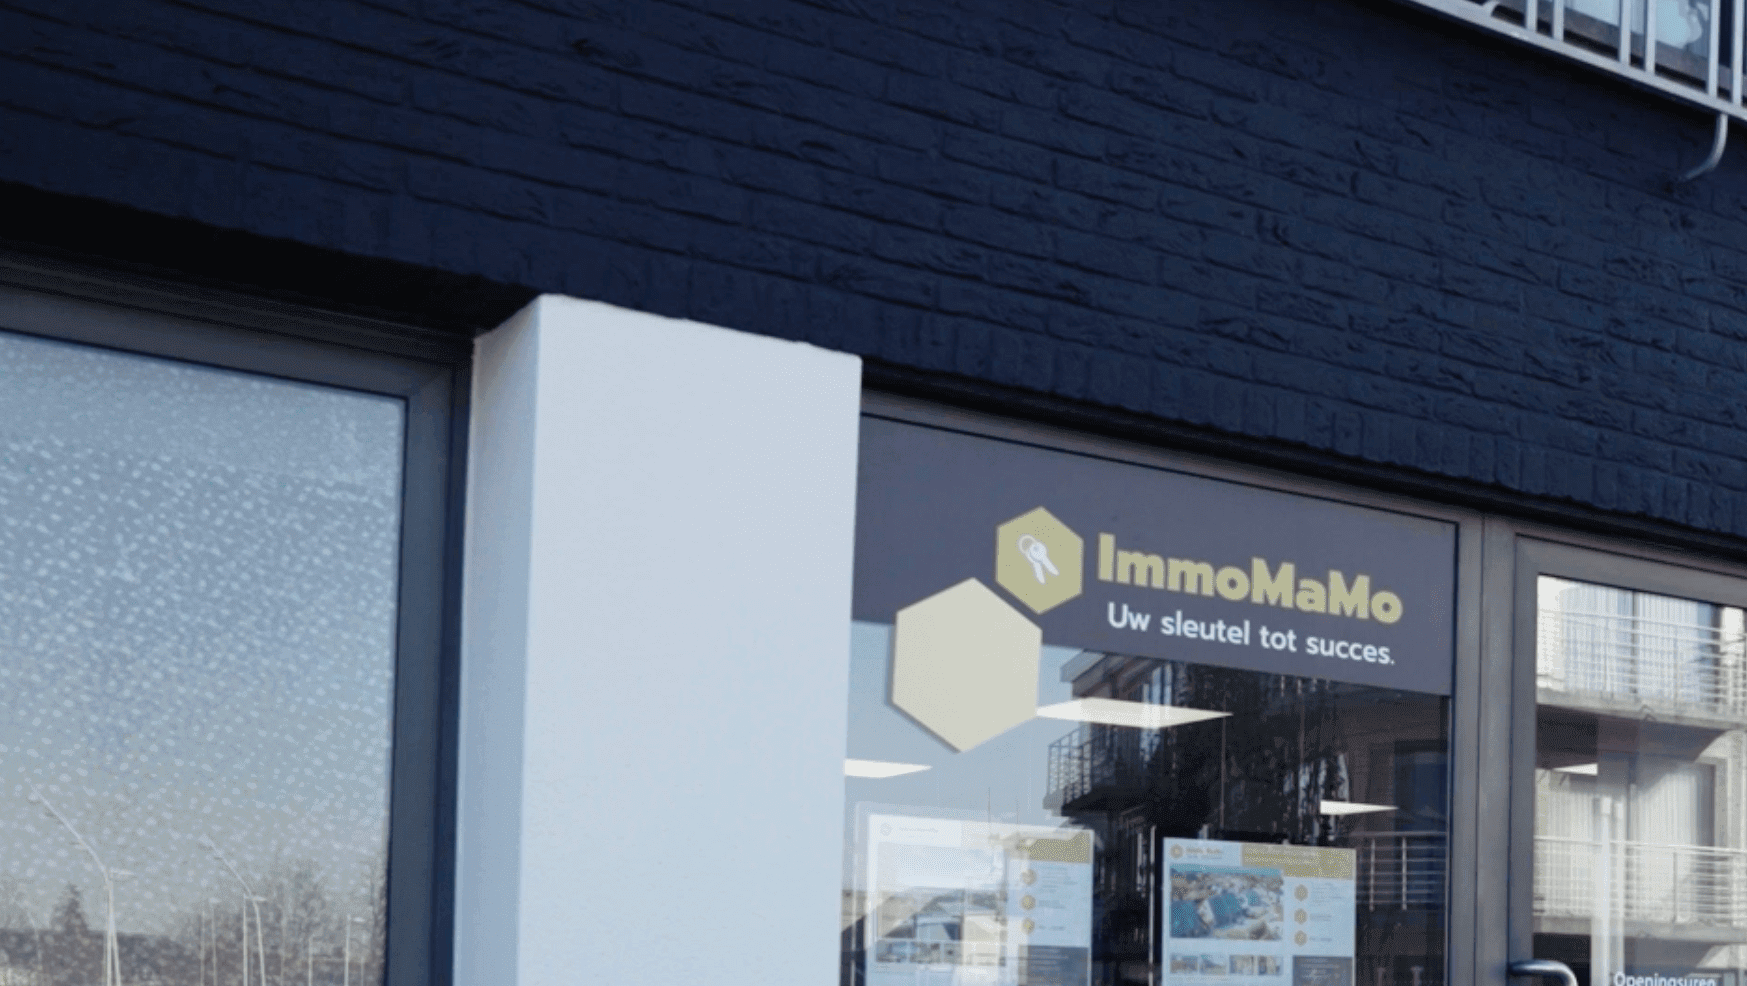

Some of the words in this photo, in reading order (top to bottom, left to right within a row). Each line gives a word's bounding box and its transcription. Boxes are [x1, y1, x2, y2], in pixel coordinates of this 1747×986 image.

[1097, 533, 1404, 625] ImmoMaMo
[1107, 601, 1151, 633] Uw
[1161, 611, 1250, 646] sleutel
[1260, 625, 1297, 653] tot
[1305, 633, 1396, 666] succes.
